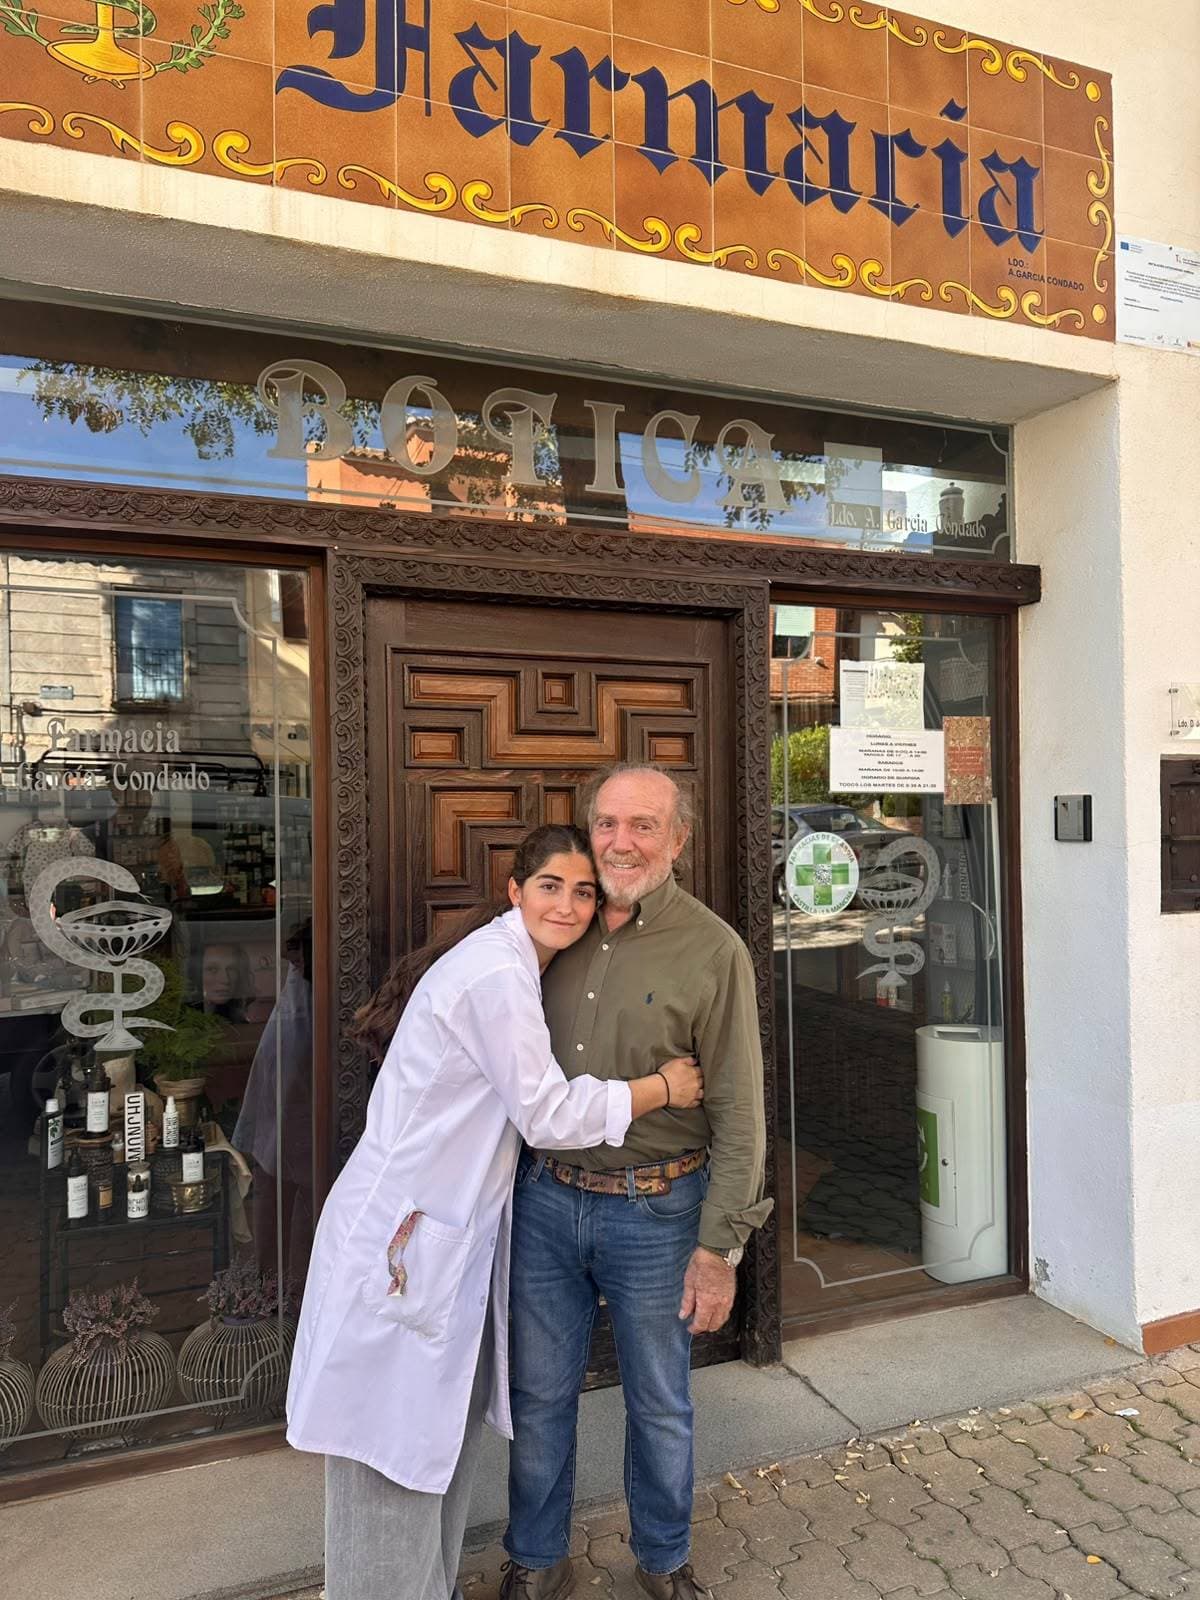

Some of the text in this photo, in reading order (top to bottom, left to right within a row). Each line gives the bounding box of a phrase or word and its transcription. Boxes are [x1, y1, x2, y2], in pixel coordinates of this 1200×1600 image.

[276, 0, 1044, 253] Farmacia
[1046, 276, 1085, 291] CONDADO
[257, 359, 793, 513] BOTICA
[830, 503, 857, 527] Ldo.
[865, 506, 880, 528] A.
[935, 513, 987, 539] Condado
[47, 717, 182, 759] Farmacia
[112, 762, 210, 795] Condado
